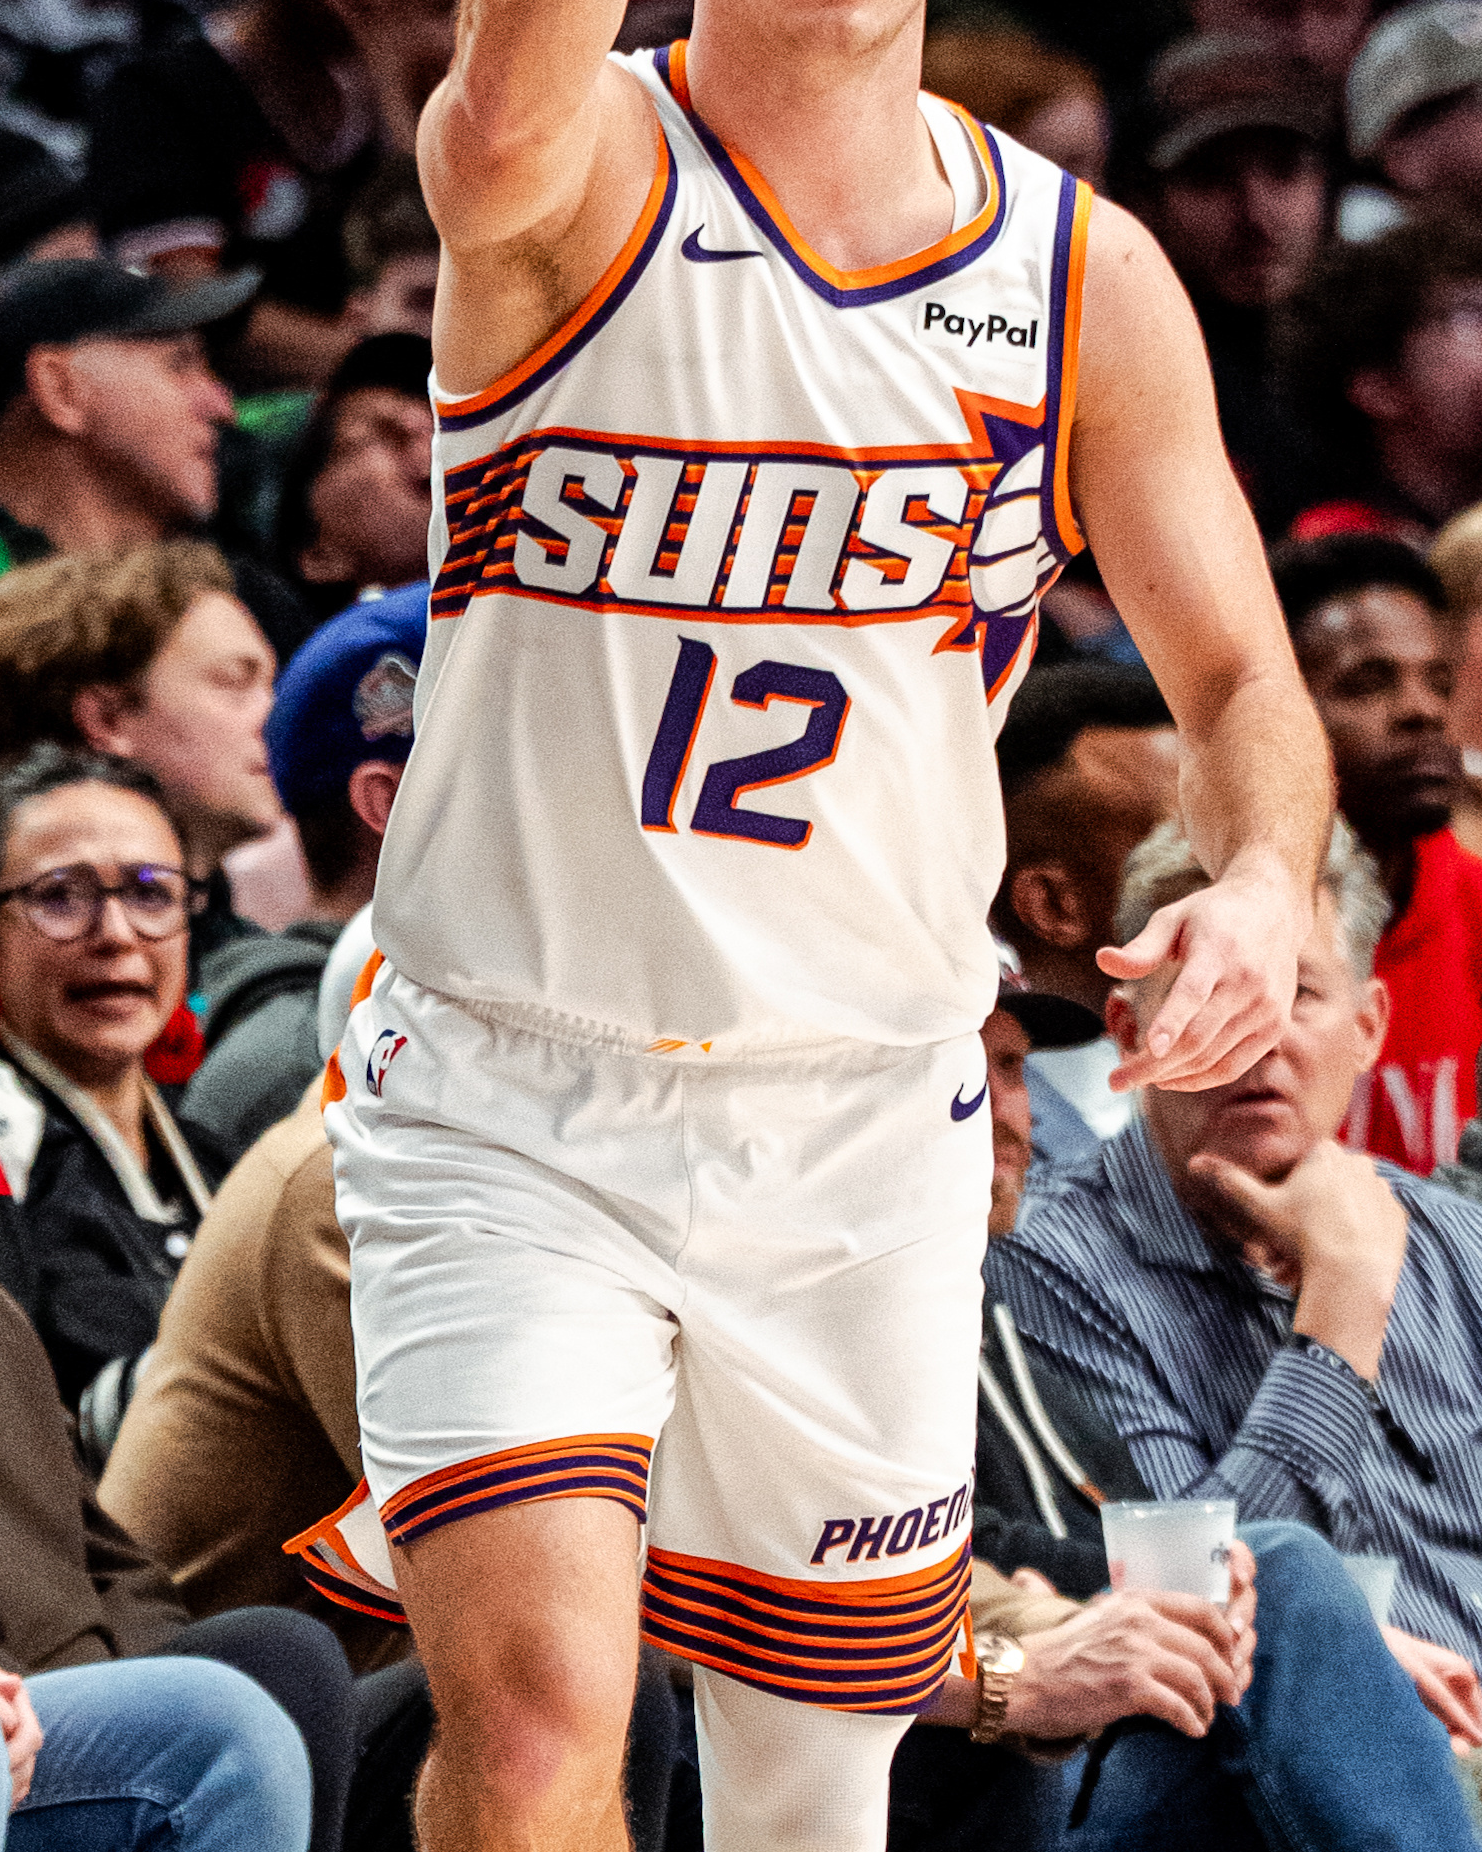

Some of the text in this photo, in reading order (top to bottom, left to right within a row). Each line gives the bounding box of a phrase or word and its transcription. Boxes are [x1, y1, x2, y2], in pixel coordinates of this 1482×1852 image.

[923, 302, 1038, 349] PayPal
[512, 446, 970, 611] SUNS
[640, 634, 852, 851] 12
